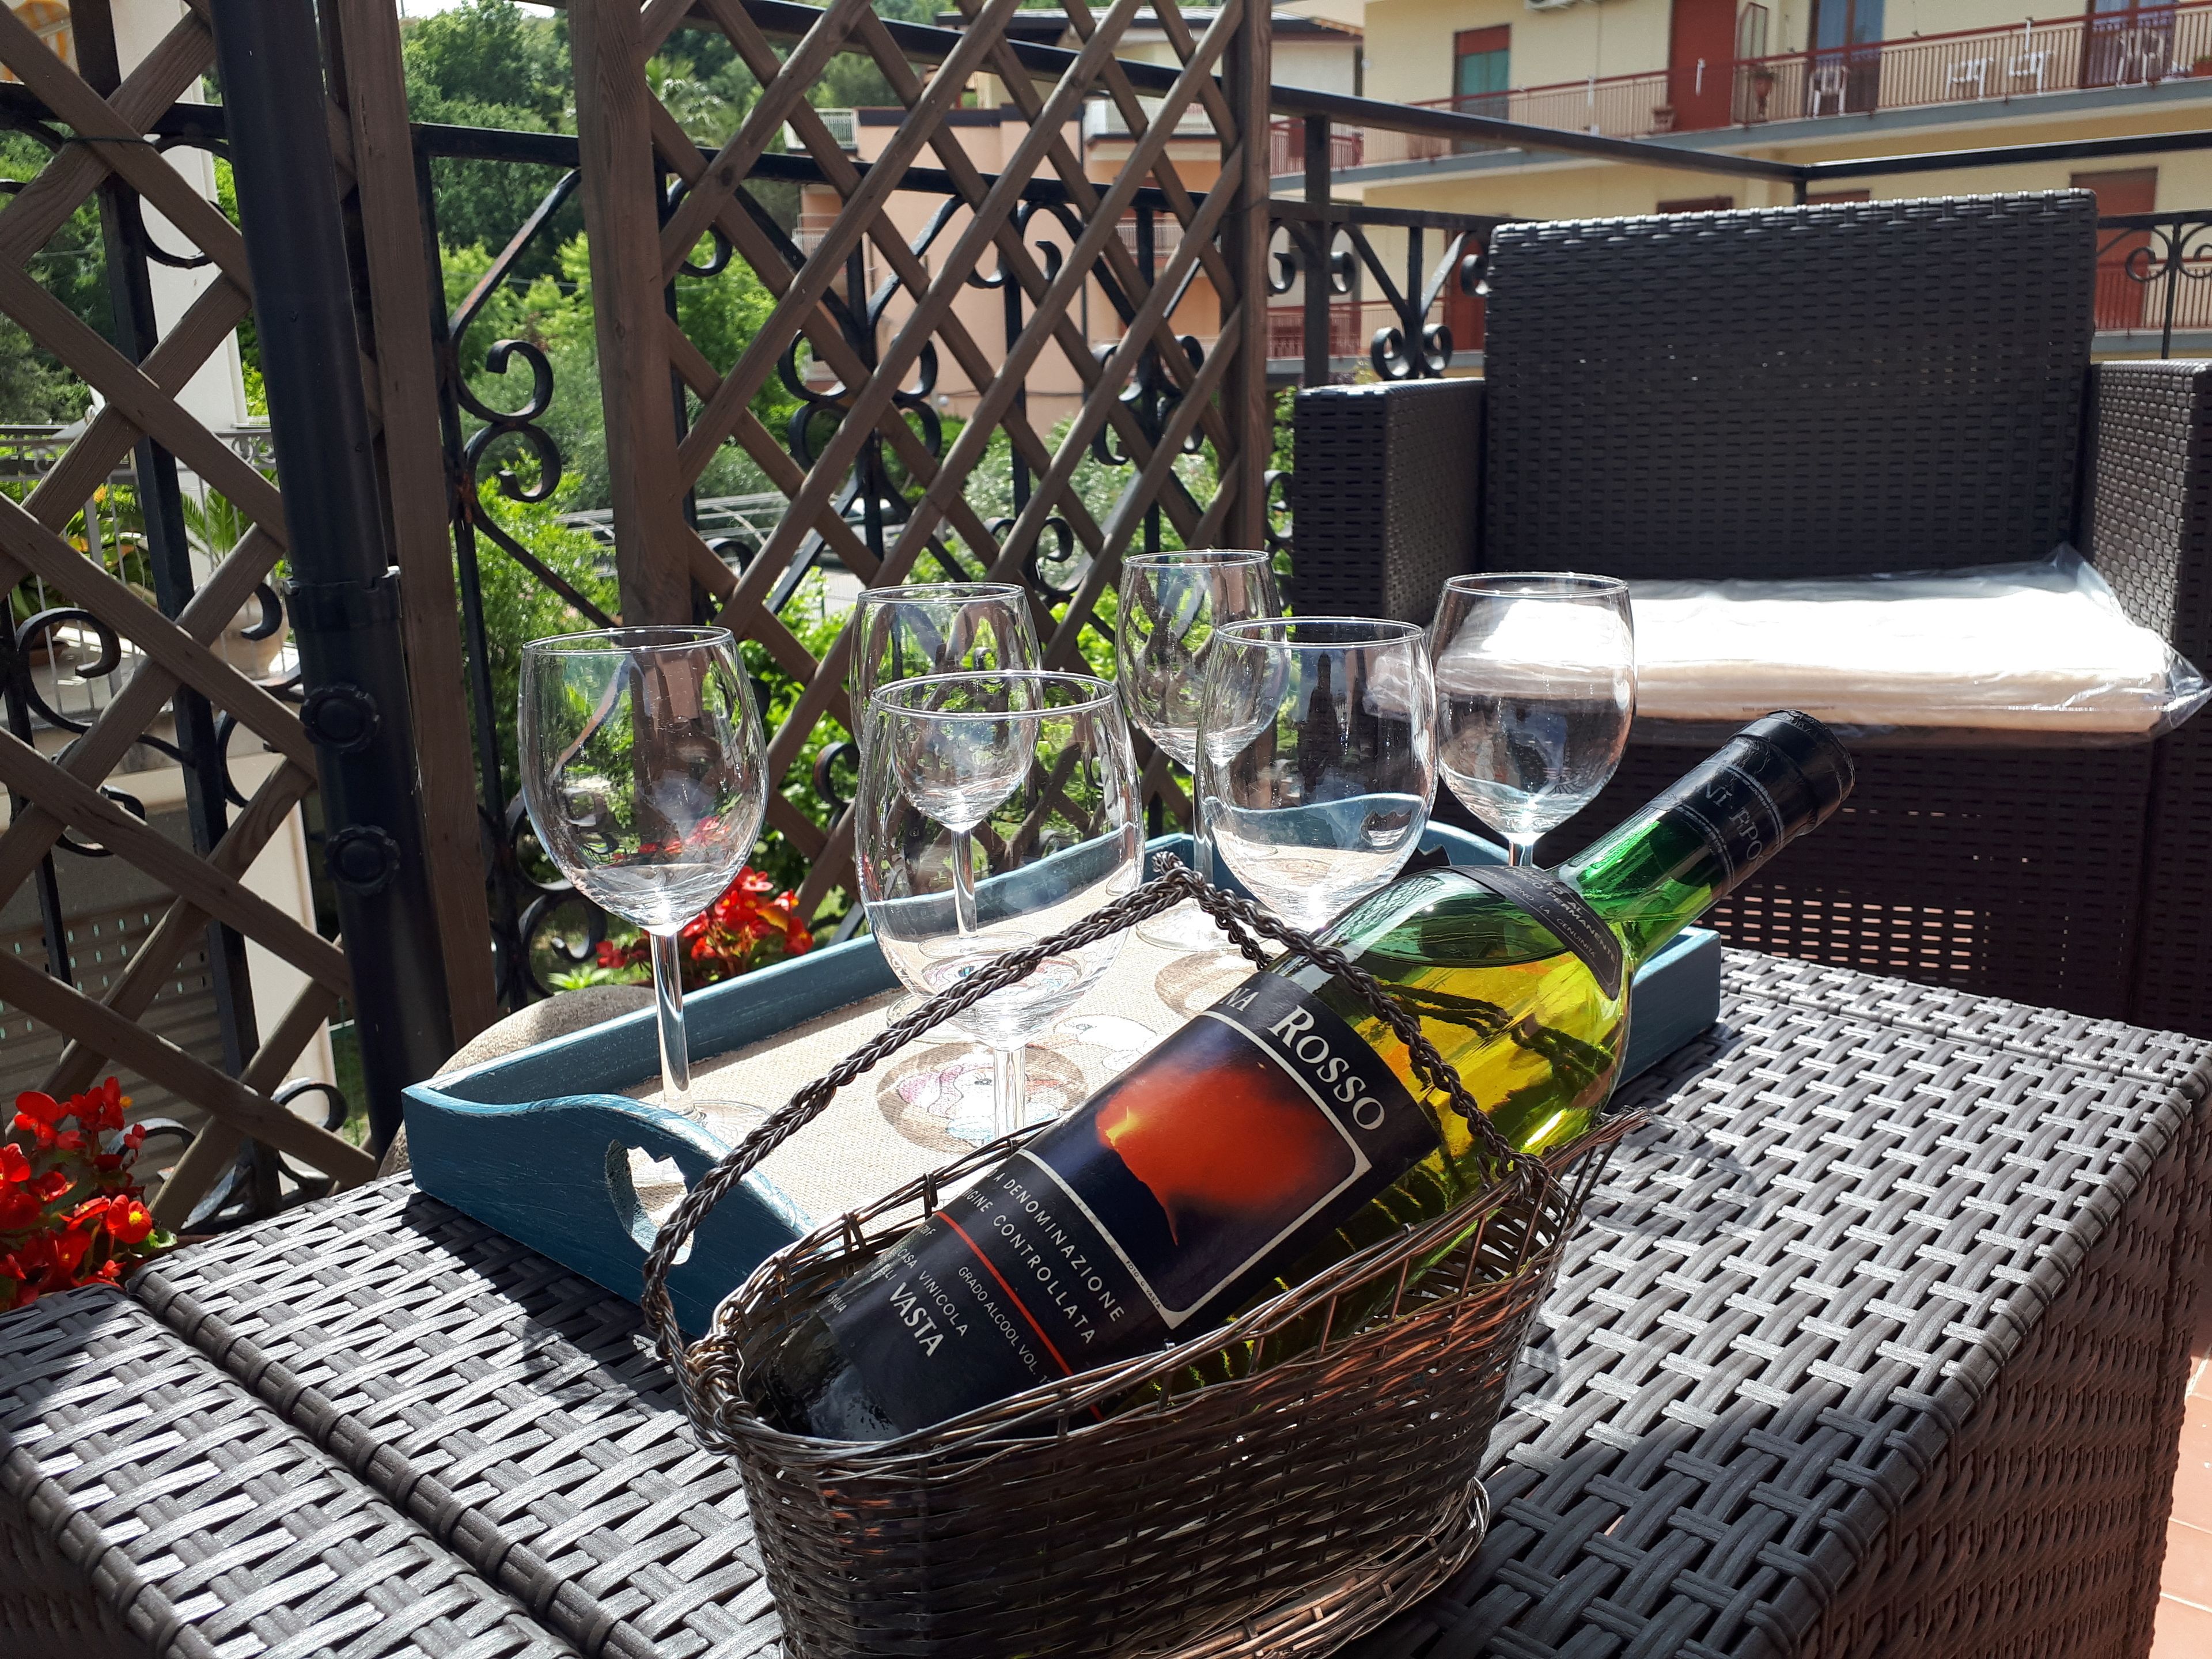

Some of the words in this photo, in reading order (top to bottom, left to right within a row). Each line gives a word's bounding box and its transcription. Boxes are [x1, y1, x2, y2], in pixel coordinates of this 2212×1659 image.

[1539, 905, 1550, 914] LA
[1546, 892, 1615, 961] PERMANENTE
[1567, 901, 1583, 915] AL
[1267, 1004, 1385, 1130] ROSSO
[993, 1214, 1094, 1343] CONTROLLATA
[994, 1172, 1005, 1182] A
[1003, 1179, 1124, 1321] DENOMINAZIONE
[1126, 1260, 1139, 1277] FOTO
[1146, 1290, 1161, 1308] VASTA
[889, 1282, 944, 1357] VASTA
[897, 1248, 918, 1269] CASA
[919, 1270, 968, 1336] VINICOLA
[958, 1267, 988, 1301] GRADO
[984, 1302, 1019, 1346] ALCOOL
[1019, 1344, 1036, 1376] VOL.
